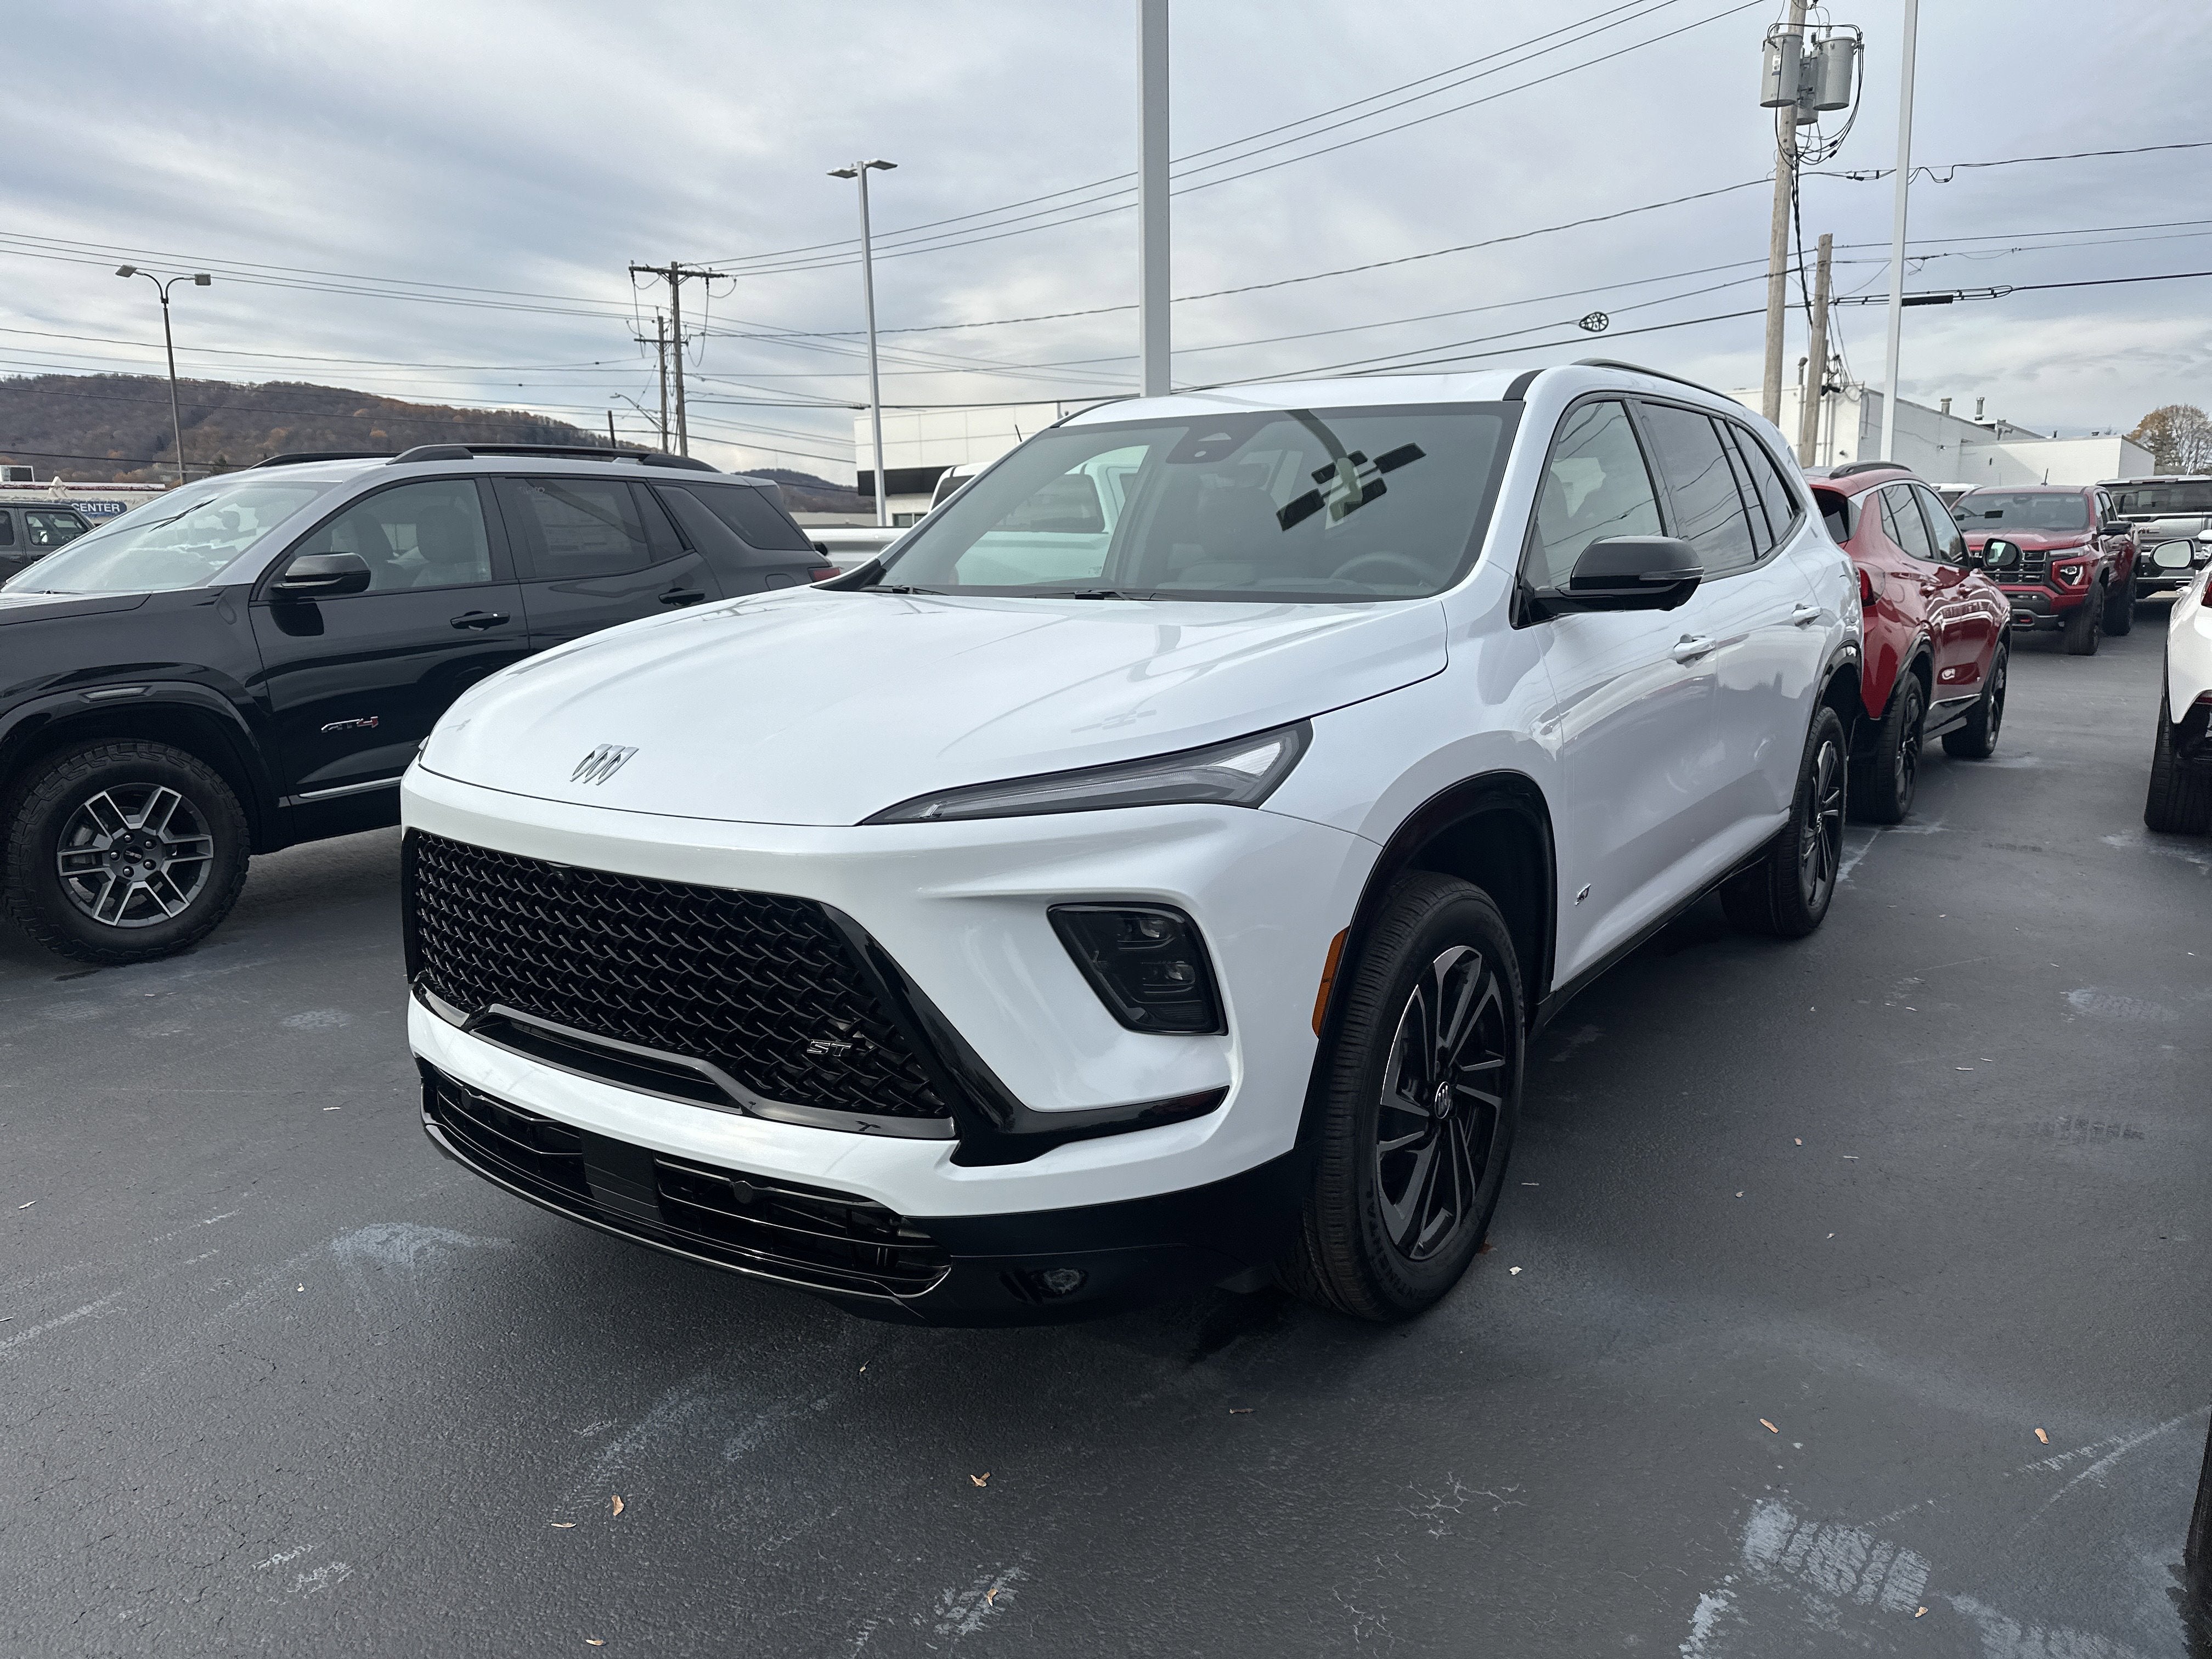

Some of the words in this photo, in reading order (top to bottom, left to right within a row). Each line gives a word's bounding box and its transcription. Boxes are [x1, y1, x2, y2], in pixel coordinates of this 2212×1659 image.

[71, 503, 120, 512] CENTER
[321, 716, 379, 733] AT4
[807, 1039, 853, 1057] ST
